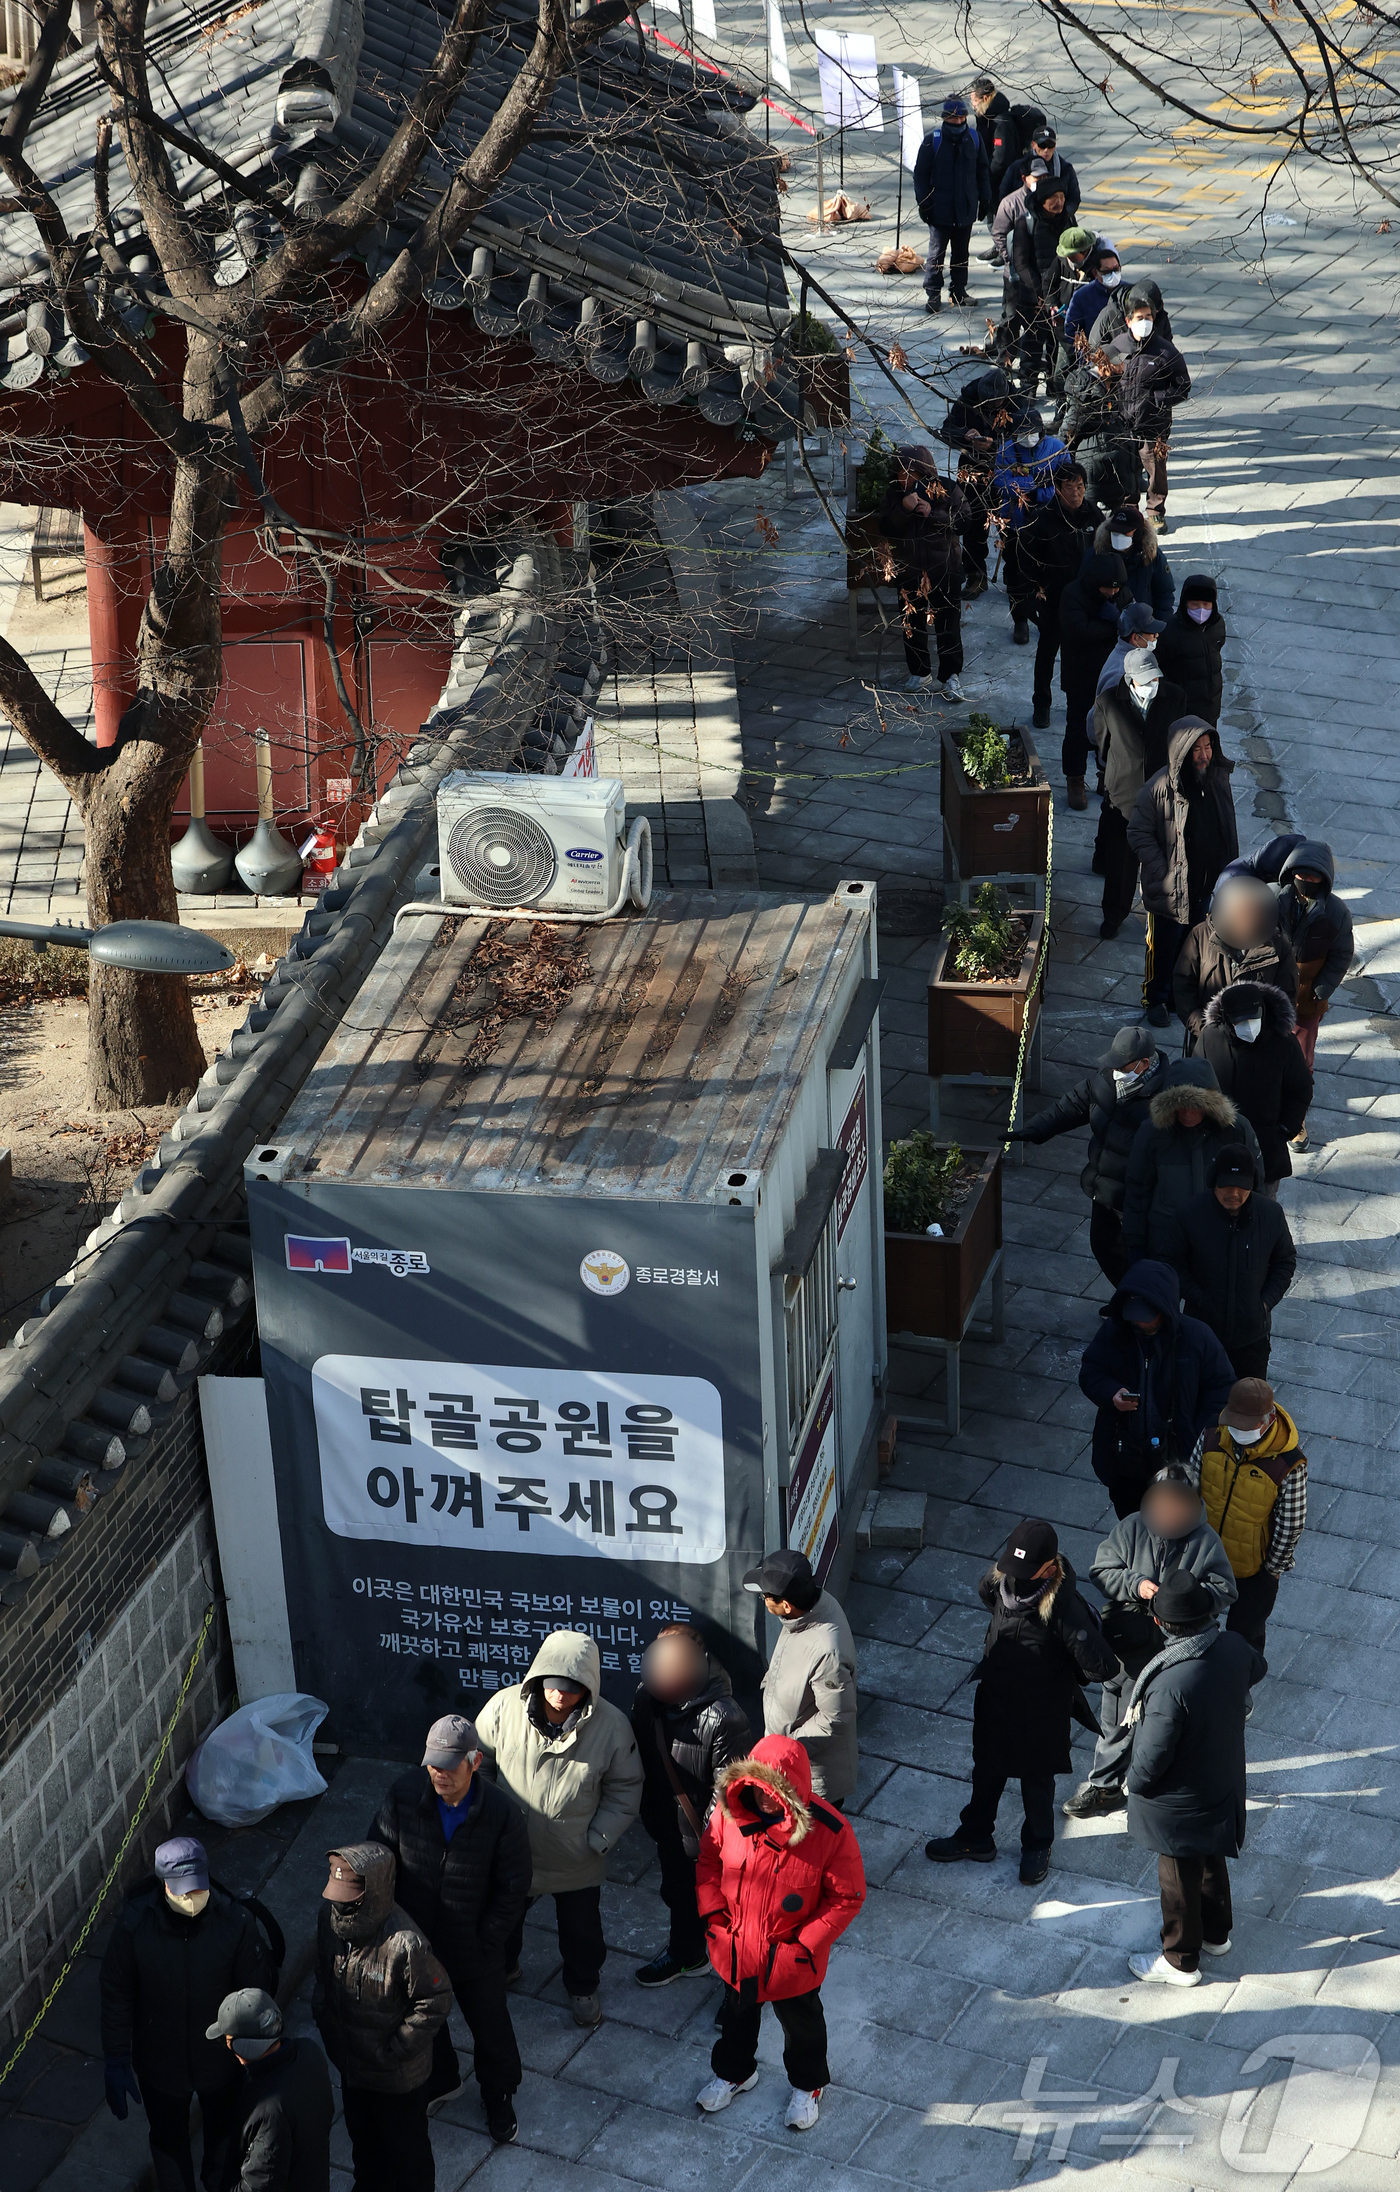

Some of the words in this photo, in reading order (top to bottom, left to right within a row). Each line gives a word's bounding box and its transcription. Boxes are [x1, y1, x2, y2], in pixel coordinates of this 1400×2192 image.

[570, 850, 599, 859] Carrier
[390, 1253, 427, 1274] 종로
[635, 1266, 719, 1287] 종로경찰서
[360, 1387, 679, 1462] 탑골공원을
[366, 1466, 683, 1537] 아껴주세요
[352, 1576, 414, 1602] 이곳은
[420, 1584, 503, 1610] 대한민국
[510, 1592, 573, 1616] 국보와
[580, 1596, 642, 1619] 보물이
[650, 1599, 692, 1622] 있는
[400, 1608, 483, 1635] 국가유산
[379, 1632, 463, 1659] 깨끗하고
[468, 1642, 531, 1667] 쾌적한
[459, 1667, 527, 1691] 만들어
